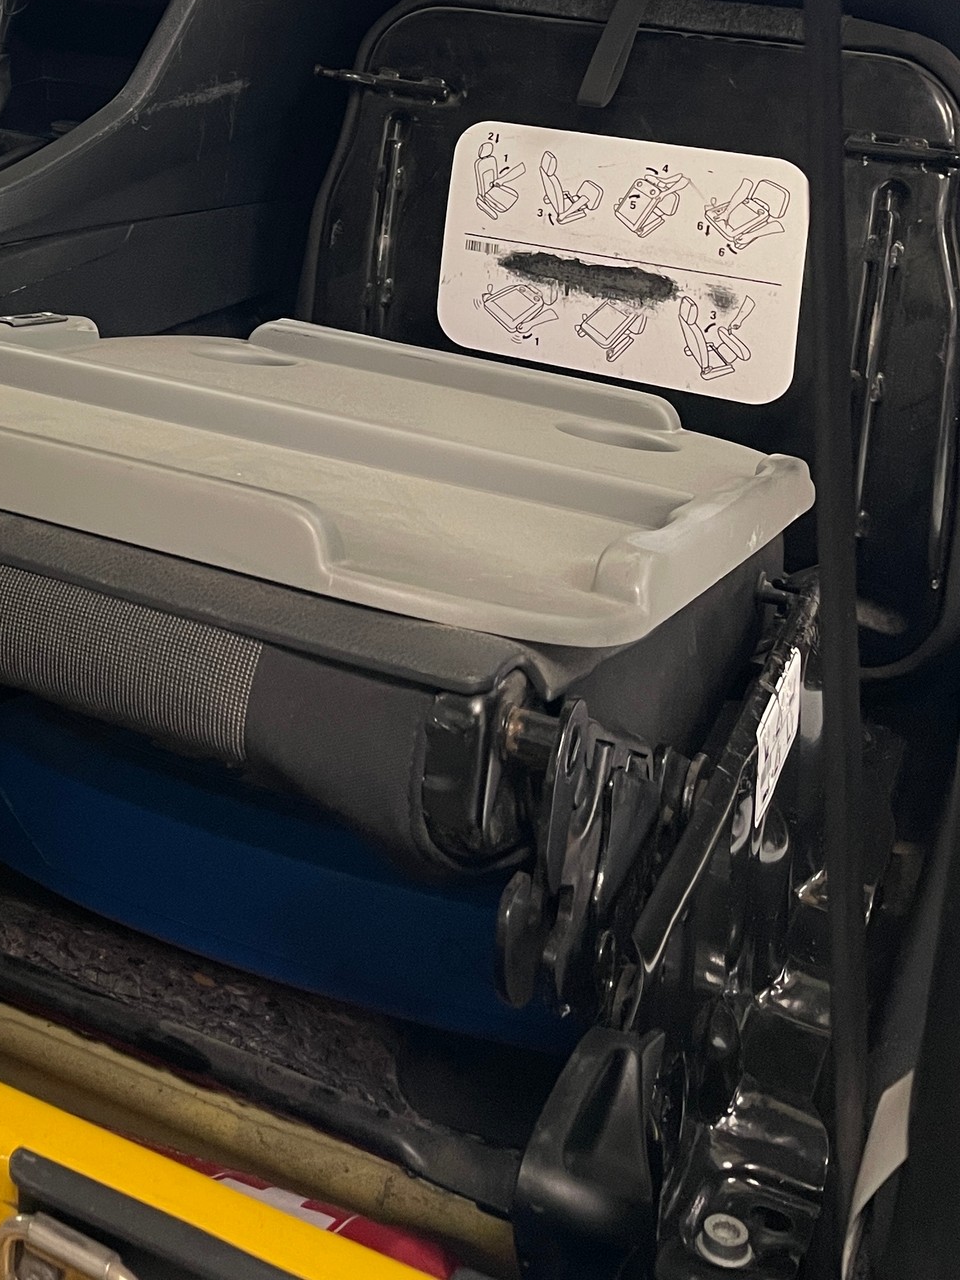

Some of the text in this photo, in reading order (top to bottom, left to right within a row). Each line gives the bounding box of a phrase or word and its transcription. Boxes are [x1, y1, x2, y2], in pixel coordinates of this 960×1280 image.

[487, 131, 494, 141] 2
[504, 153, 508, 163] 1
[662, 164, 669, 173] 4
[629, 200, 637, 210] 5
[537, 208, 544, 218] 3
[696, 221, 704, 231] 6
[718, 247, 725, 257] 6
[709, 310, 717, 320] 3
[534, 337, 539, 346] 1
